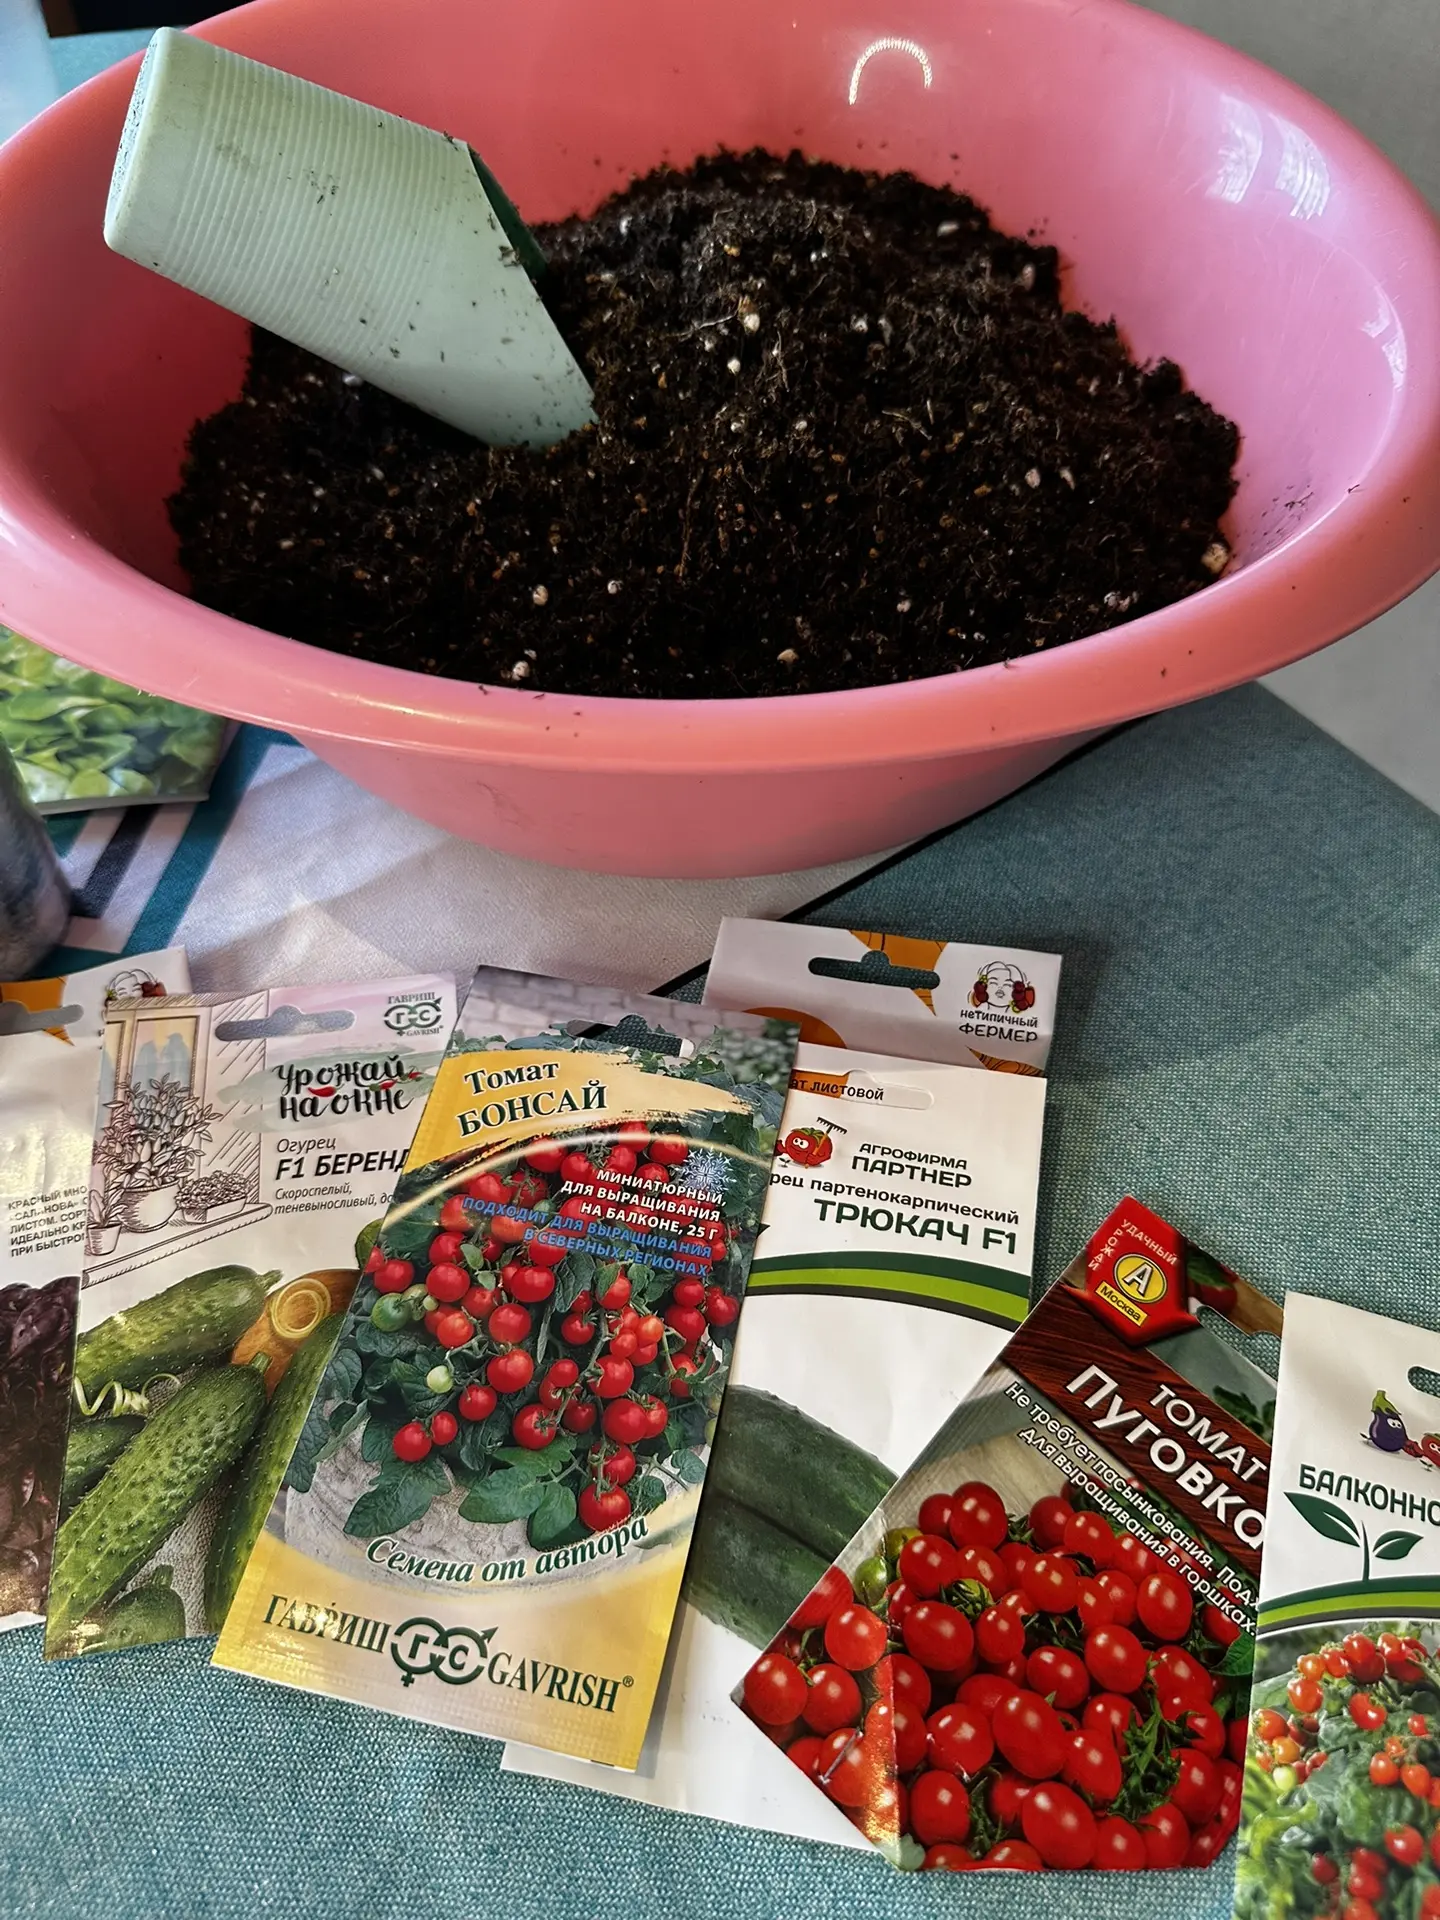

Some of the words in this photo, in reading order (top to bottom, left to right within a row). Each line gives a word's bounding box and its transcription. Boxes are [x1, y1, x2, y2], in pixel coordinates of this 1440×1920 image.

[388, 992, 435, 1004] ГАВРИШ
[959, 1022, 1038, 1042] ФЕРМЕР
[464, 1063, 559, 1095] Томат
[810, 1081, 885, 1101] листовой
[457, 1079, 608, 1137] БОНСАЙ
[276, 1137, 337, 1155] Огурец
[858, 1142, 968, 1170] АГРОФИРМА
[275, 1156, 306, 1181] F1
[851, 1155, 973, 1189] ПАРТНЕР
[274, 1194, 378, 1215] теневыносливый,
[275, 1182, 353, 1200] Скороспелый,
[560, 1180, 594, 1198] ДЛЯ
[597, 1187, 721, 1223] ВЫРАЩИВАНИЯ
[596, 1169, 727, 1207] МИНИАТЮРНЫЙ,
[810, 1179, 1020, 1225] партенокарпический
[9, 1216, 58, 1235] ЛИСТОМ.
[10, 1224, 70, 1246] ИДЕАЛЬНО
[462, 1196, 548, 1225] ПОДХОДИТ
[551, 1216, 584, 1233] ДЛЯ
[586, 1223, 712, 1259] ВЫРАЩИВАНИЯ
[580, 1201, 602, 1215] НА
[605, 1207, 683, 1235] БАЛКОНЕ,
[686, 1224, 706, 1238] 25
[814, 1198, 970, 1246] ТРЮКАЧ
[982, 1227, 1017, 1255] F1
[11, 1245, 34, 1257] ПРИ
[523, 1229, 534, 1242] В
[537, 1232, 622, 1259] СЕВЕРНЫХ
[624, 1248, 709, 1277] РЕГИОНАХ
[1121, 1219, 1179, 1266] УДАЧНЫЙ
[1100, 1285, 1142, 1321] Москва
[1149, 1384, 1268, 1482] ТОМАТ
[1004, 1382, 1031, 1408] Не
[1029, 1403, 1097, 1463] требует
[1092, 1459, 1214, 1572] пасынкования.
[1299, 1463, 1440, 1527] БАЛКОННО
[367, 1537, 472, 1583] Семена
[481, 1557, 526, 1582] от
[535, 1517, 650, 1574] автора
[1053, 1454, 1175, 1557] выращивания
[1166, 1551, 1181, 1568] в
[1180, 1564, 1256, 1636] горшках.
